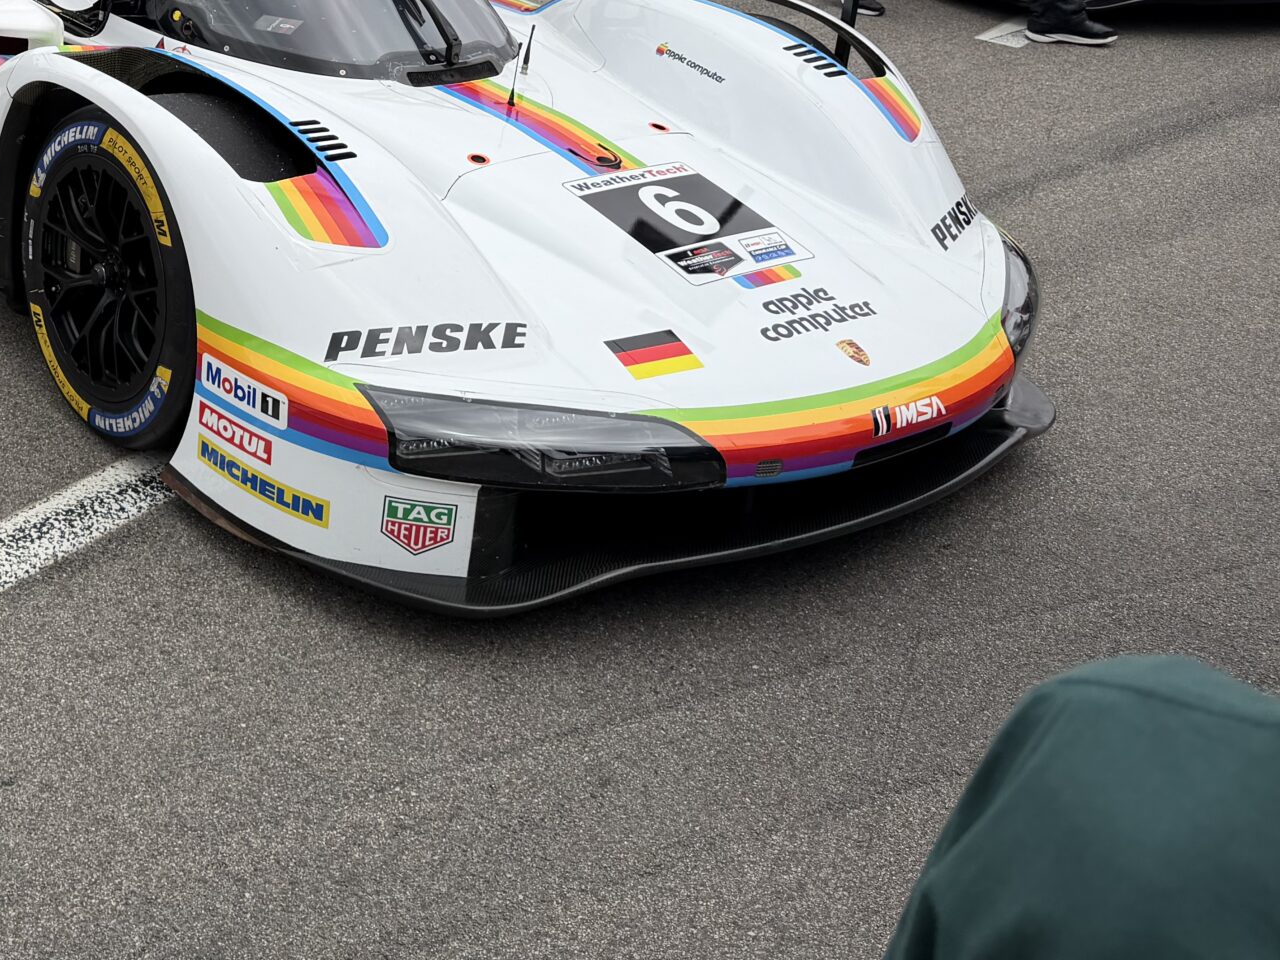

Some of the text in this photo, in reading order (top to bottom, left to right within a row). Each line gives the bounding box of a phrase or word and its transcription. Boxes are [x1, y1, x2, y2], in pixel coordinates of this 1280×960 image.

[665, 48, 725, 84] apple computer
[42, 125, 98, 170] MICHELIN
[108, 137, 148, 187] PILOT SPORT
[571, 164, 687, 195] WeatherTech
[637, 185, 721, 235] 6
[930, 191, 978, 252] PENSK
[677, 249, 733, 267] WeatherTech
[760, 298, 877, 342] computer
[762, 286, 837, 316] apple
[324, 322, 528, 363] PENSKE
[49, 360, 83, 411] PILOT SPORT
[206, 362, 257, 409] Mobil
[95, 396, 155, 433] MICHELIN
[895, 396, 947, 429] IMSA
[201, 409, 270, 460] MOTUL
[201, 440, 325, 522] MICHELIN
[390, 502, 449, 524] TAG
[386, 522, 448, 552] HEUER
